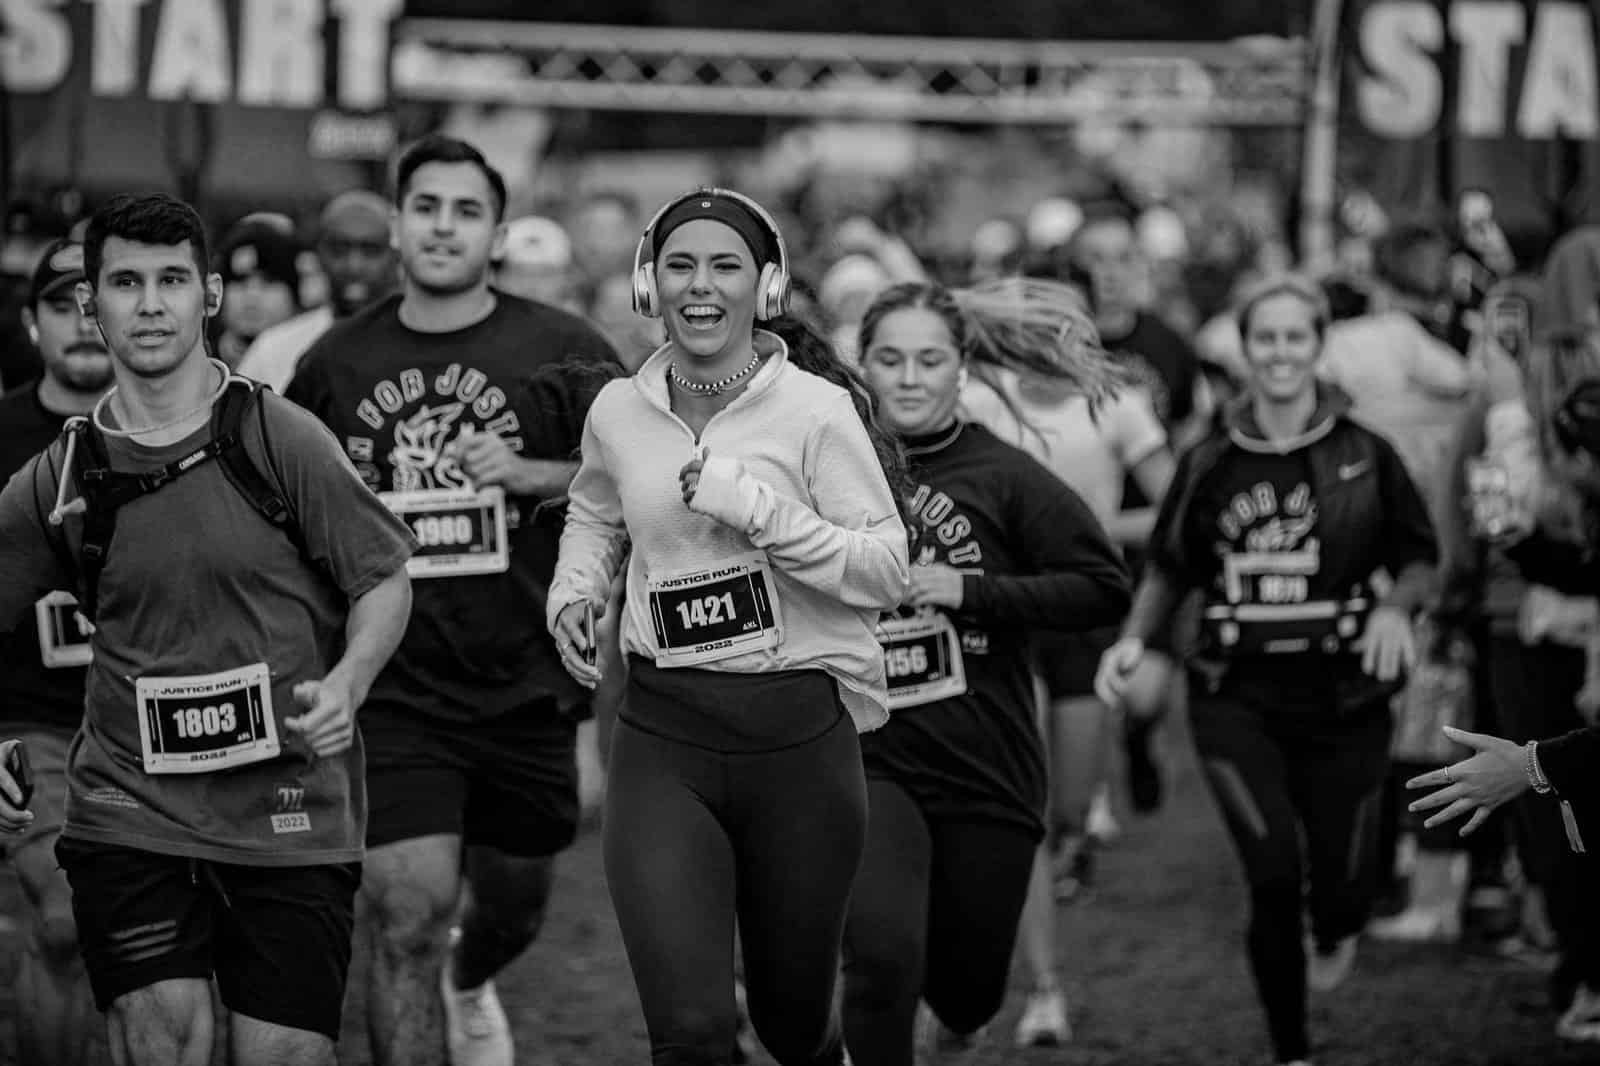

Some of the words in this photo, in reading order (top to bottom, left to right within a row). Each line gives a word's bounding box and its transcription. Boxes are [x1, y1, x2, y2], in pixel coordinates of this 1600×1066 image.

[0, 0, 398, 110] START
[1357, 0, 1600, 141] STA
[356, 368, 426, 430] FOR
[660, 572, 712, 588] JUSTICE
[712, 565, 741, 580] RUN
[675, 591, 737, 630] 1421
[695, 640, 734, 653] 2022
[160, 684, 214, 696] JUSTICE
[215, 677, 243, 691] RUN
[172, 702, 237, 739] 1803
[277, 815, 305, 828] 2022
